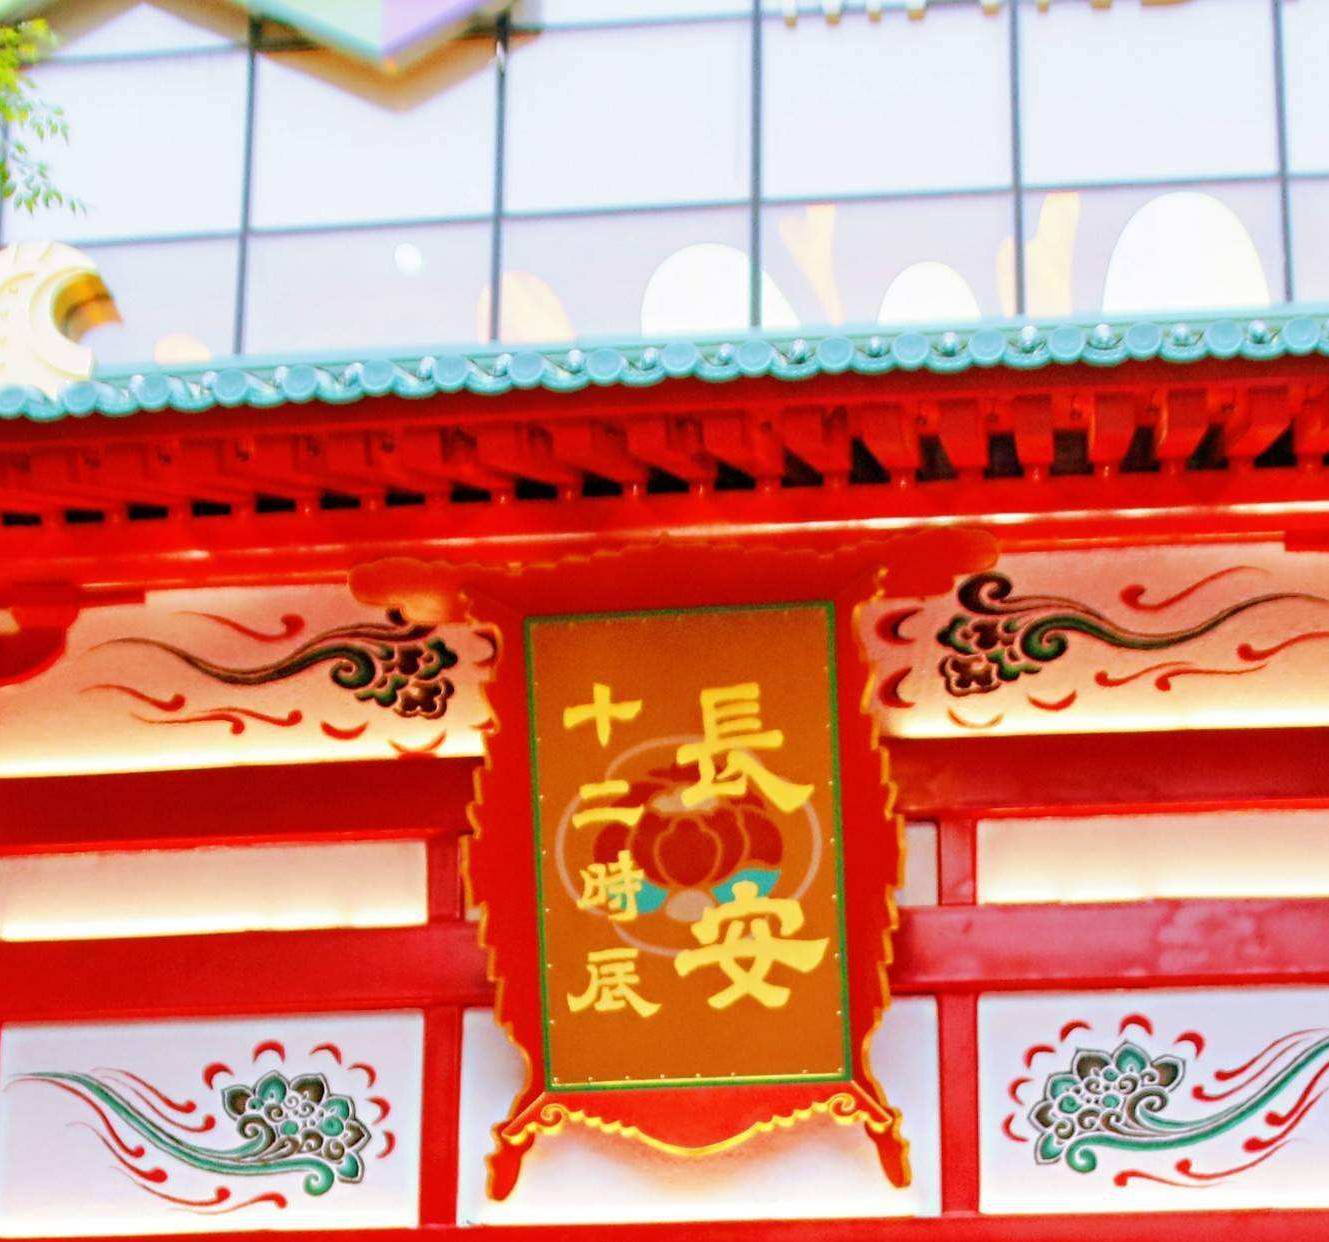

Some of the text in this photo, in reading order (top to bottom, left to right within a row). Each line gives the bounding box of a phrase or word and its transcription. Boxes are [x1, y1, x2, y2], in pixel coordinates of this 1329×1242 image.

[563, 682, 662, 1018] 十二時辰
[674, 681, 830, 1010] 長安
